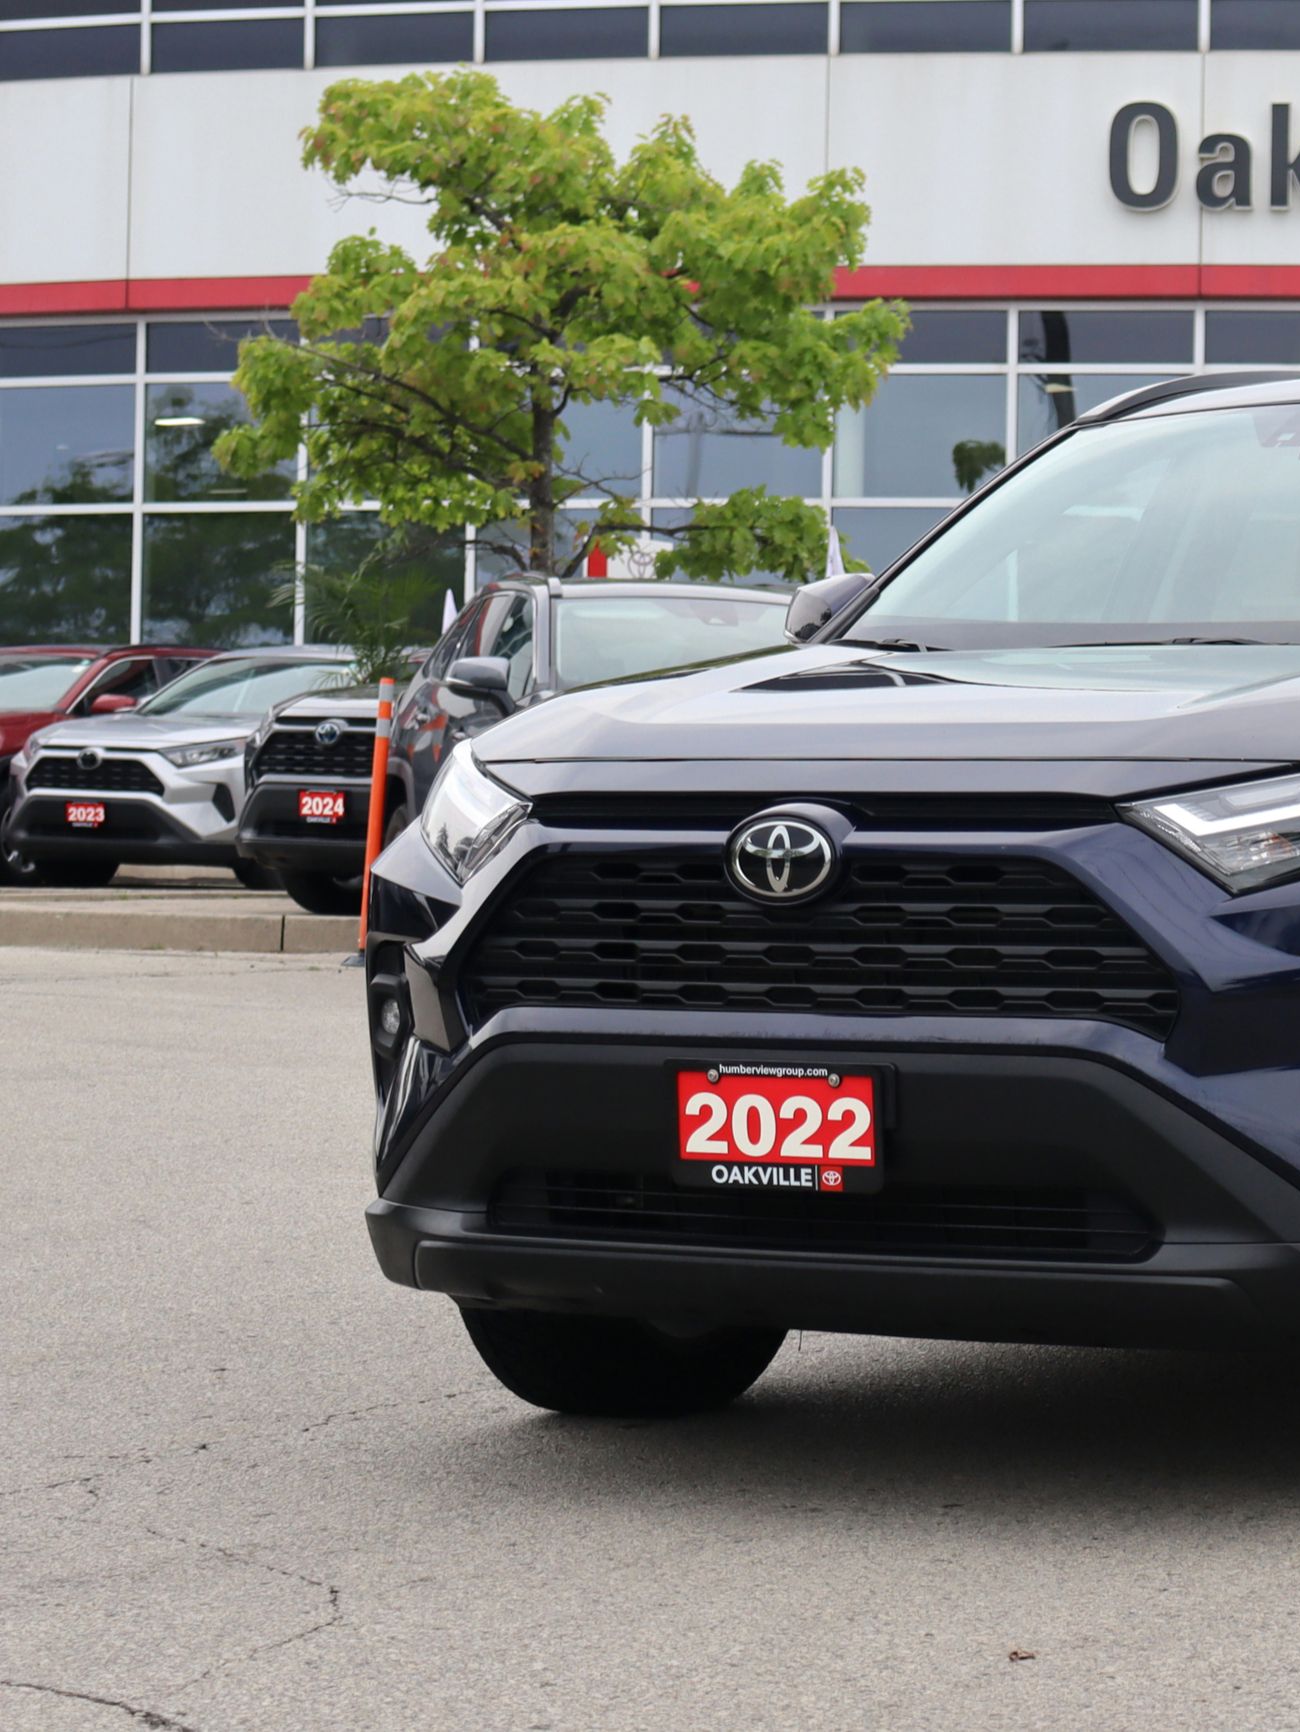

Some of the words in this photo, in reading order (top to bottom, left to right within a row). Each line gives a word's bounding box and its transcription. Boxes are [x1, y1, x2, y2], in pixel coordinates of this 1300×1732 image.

[67, 806, 105, 822] 2023
[301, 796, 345, 816] 2024
[718, 1063, 829, 1078] humberviewgroup.com
[684, 1091, 872, 1161] 2022
[711, 1164, 814, 1187] OAKVILLE
